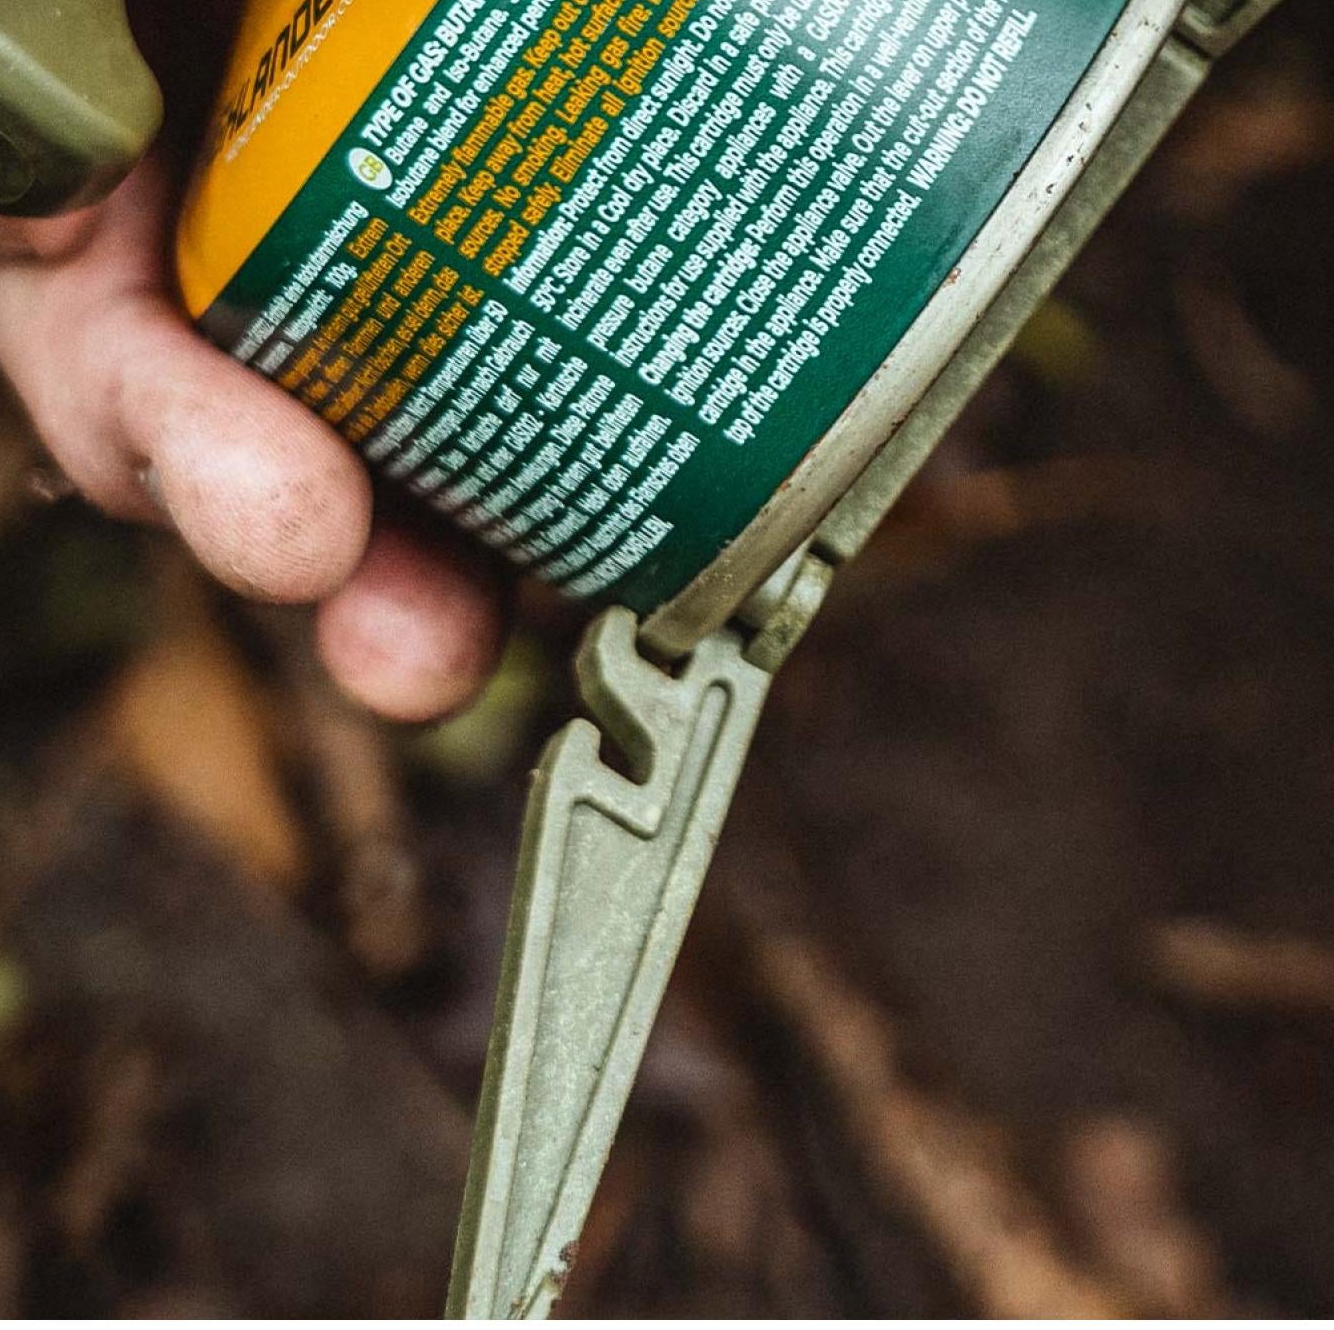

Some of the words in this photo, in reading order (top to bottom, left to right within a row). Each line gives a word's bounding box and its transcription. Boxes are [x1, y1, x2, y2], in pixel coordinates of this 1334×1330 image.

[361, 99, 403, 146] TYPE
[390, 76, 418, 108] OF
[408, 40, 448, 83] GAS:
[384, 115, 428, 165] Butane
[407, 162, 467, 226] Extremely
[452, 93, 513, 164] flammable
[505, 66, 537, 99] gas.
[522, 28, 563, 69] Keep
[551, 1, 580, 30] out
[427, 107, 467, 150] blend
[472, 21, 529, 93] enhanced
[433, 203, 472, 245] place.
[457, 169, 497, 207] Keep
[485, 134, 523, 174] away
[507, 100, 545, 138] from
[532, 65, 574, 104] heat,
[558, 37, 590, 68] hot
[459, 207, 504, 258] sources.
[492, 184, 520, 207] No
[511, 123, 568, 186] smoking.
[555, 64, 611, 124] Leaking
[617, 2, 651, 36] fire:
[553, 245, 590, 283] Store
[598, 186, 633, 222] Cool
[640, 124, 683, 171] place.
[668, 68, 718, 126] Discard
[728, 10, 760, 45] safe
[560, 168, 607, 221] Protect
[594, 135, 632, 174] from
[621, 94, 661, 140] direct
[650, 37, 705, 102] sunlight.
[355, 153, 385, 183] GB
[481, 220, 530, 277] stopped
[520, 180, 563, 226] safely.
[550, 115, 608, 182] Eliminate
[556, 267, 614, 330] incinerate
[604, 238, 637, 273] even
[625, 205, 659, 242] after
[648, 182, 679, 211] use.
[664, 151, 700, 184] This
[688, 91, 744, 158] cartridge
[731, 53, 768, 96] must
[756, 23, 792, 60] only
[587, 294, 636, 351] pressure
[625, 243, 673, 293] butane
[666, 178, 723, 242] category
[713, 101, 777, 179] appliances
[769, 63, 803, 99] with
[611, 294, 676, 367] instructions
[695, 196, 749, 262] supplied
[735, 167, 770, 203] with
[775, 77, 837, 150] appliance.
[820, 45, 854, 80] This
[697, 367, 749, 425] cartridge
[764, 268, 825, 337] appliance.
[810, 228, 851, 271] Make
[841, 198, 873, 233] sure
[860, 166, 895, 201] that
[901, 88, 948, 144] cut-out
[934, 39, 978, 94] section
[702, 309, 750, 362] sources.
[736, 273, 776, 314] Close
[781, 187, 841, 257] appliance
[826, 150, 867, 191] valve.
[852, 120, 885, 153] Out
[886, 61, 923, 102] lever
[924, 2, 962, 50] upper
[766, 329, 822, 391] cartridge
[816, 262, 873, 326] properly
[856, 189, 921, 268] connected.
[909, 111, 973, 189] WARNING:
[956, 85, 987, 117] DO
[972, 53, 1006, 93] NOT
[991, 7, 1036, 61] REFILL.
[347, 216, 388, 258] Extrem
[392, 249, 434, 296] anderen
[432, 266, 459, 291] das
[639, 323, 700, 386] Changing
[682, 300, 713, 329] the
[702, 237, 762, 306] cartridge:
[746, 183, 799, 243] Perform
[786, 155, 819, 188] this
[808, 91, 867, 162] operation
[465, 315, 497, 344] über
[483, 299, 508, 322] 50
[485, 319, 534, 372] Gebrauch
[516, 363, 540, 388] nur
[534, 336, 561, 362] mit
[537, 355, 587, 410] Kartusche
[551, 414, 586, 445] Diese
[570, 374, 615, 419] Patrone
[600, 462, 631, 491] oben
[621, 413, 671, 467] ausfahren.
[666, 430, 700, 463] oben
